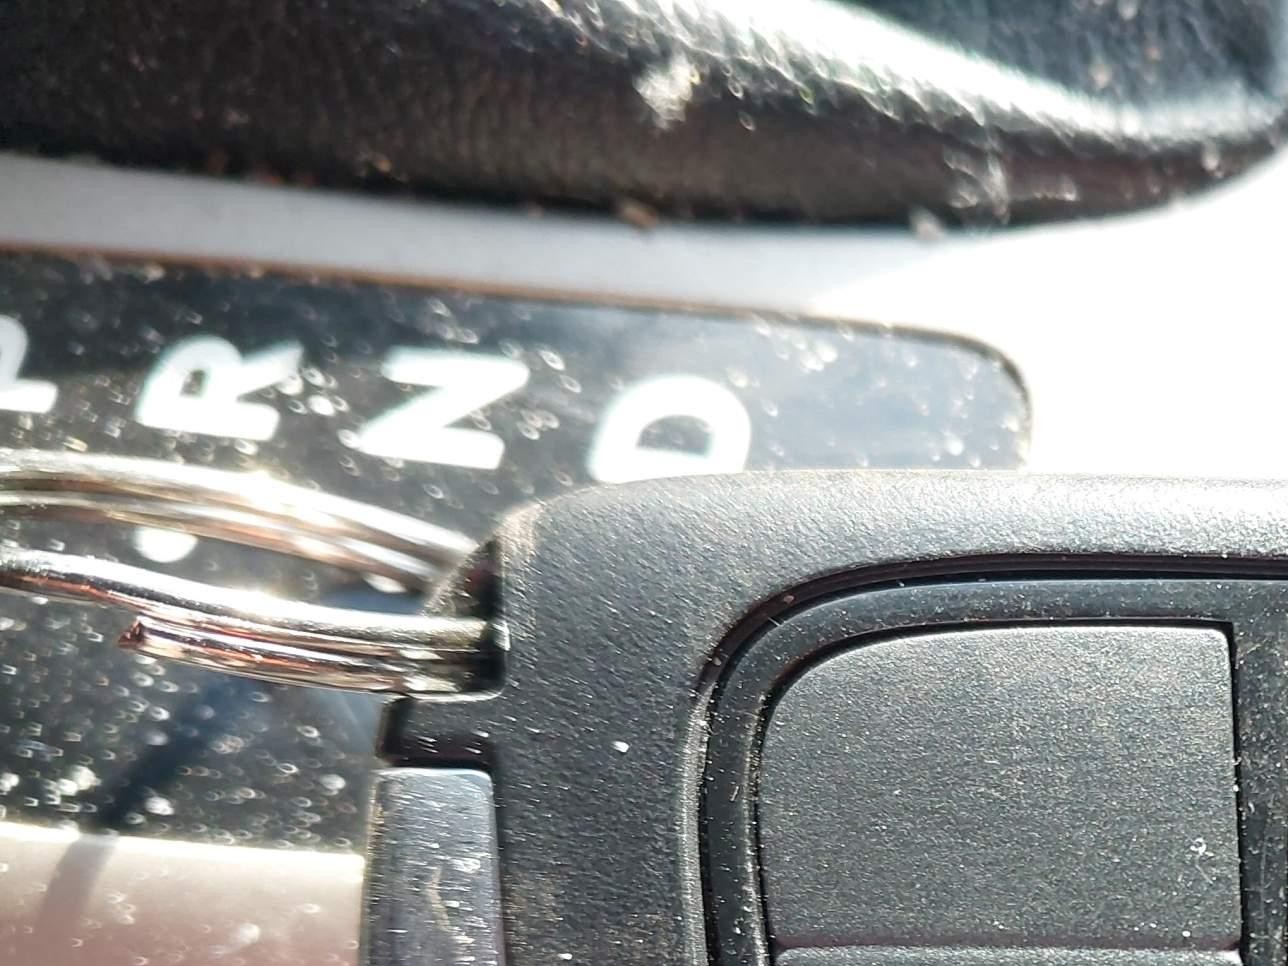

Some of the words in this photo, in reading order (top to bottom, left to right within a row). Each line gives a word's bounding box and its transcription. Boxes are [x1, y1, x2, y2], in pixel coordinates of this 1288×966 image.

[136, 336, 303, 442] R
[345, 346, 530, 470] N
[587, 374, 752, 483] D
